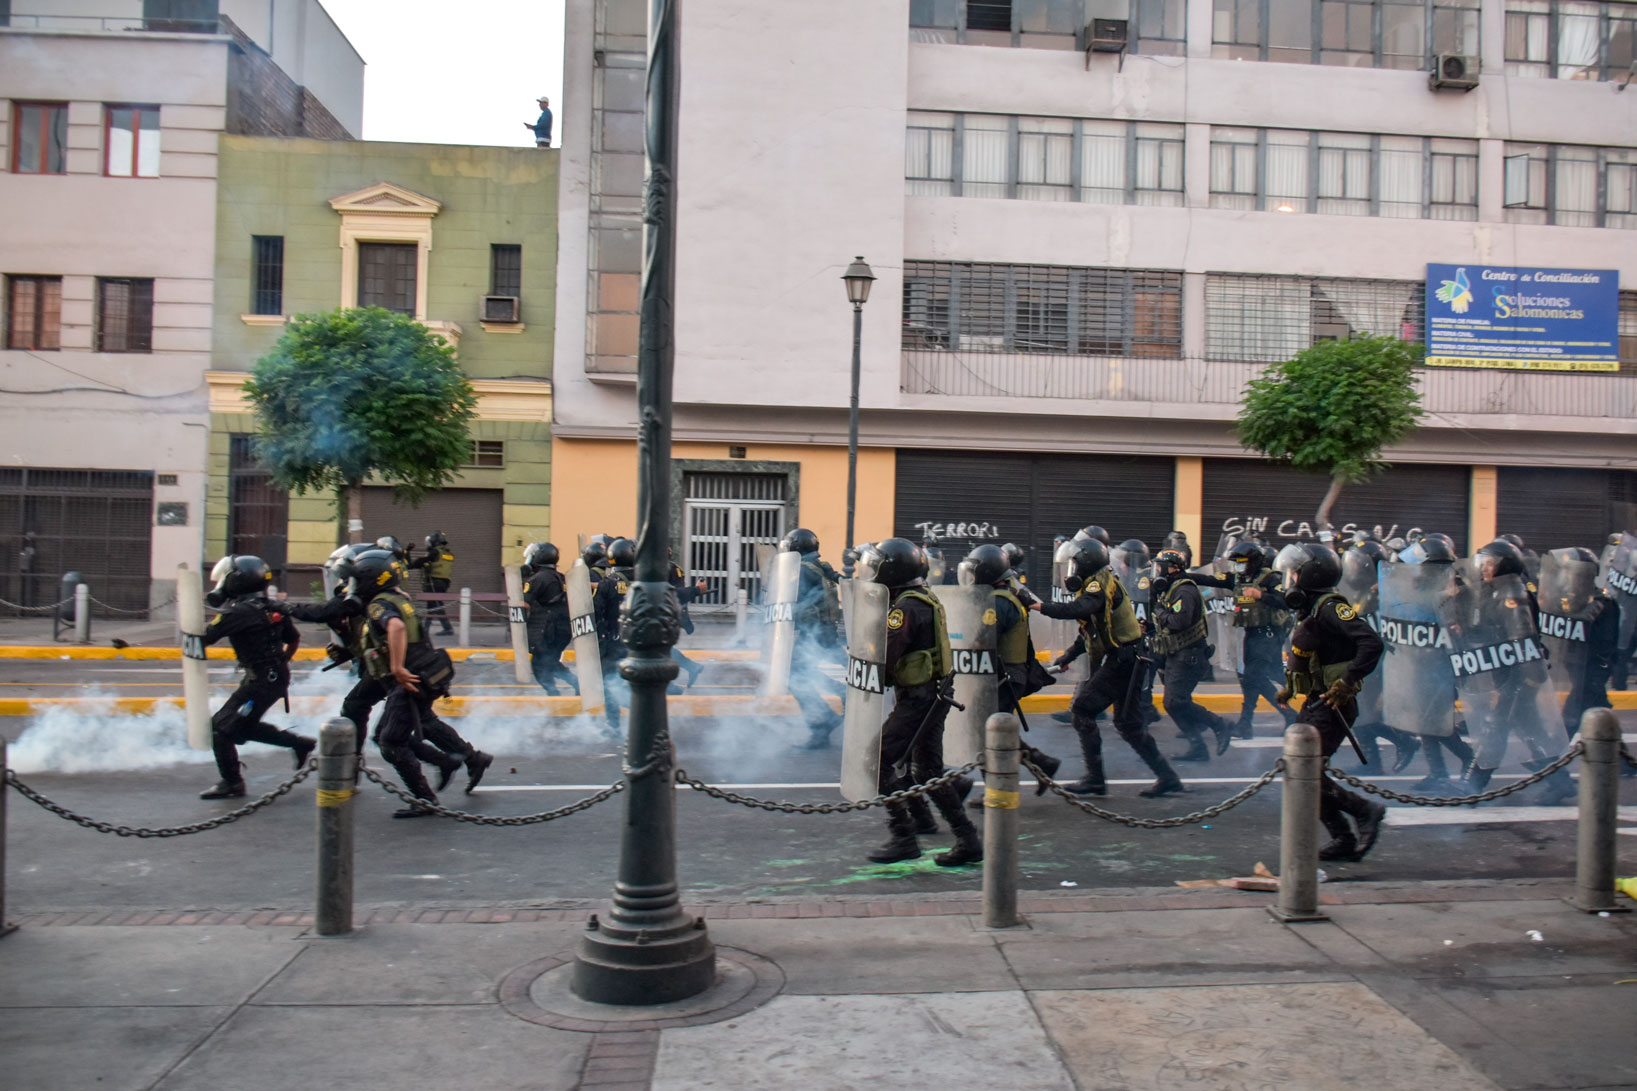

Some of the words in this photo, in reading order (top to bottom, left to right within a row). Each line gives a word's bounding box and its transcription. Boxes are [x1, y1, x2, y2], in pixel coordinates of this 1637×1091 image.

[1481, 269, 1518, 281] Centro
[1534, 271, 1600, 283] Conciliación
[1492, 285, 1571, 308] Soluciones
[1450, 638, 1541, 677] POLICIA
